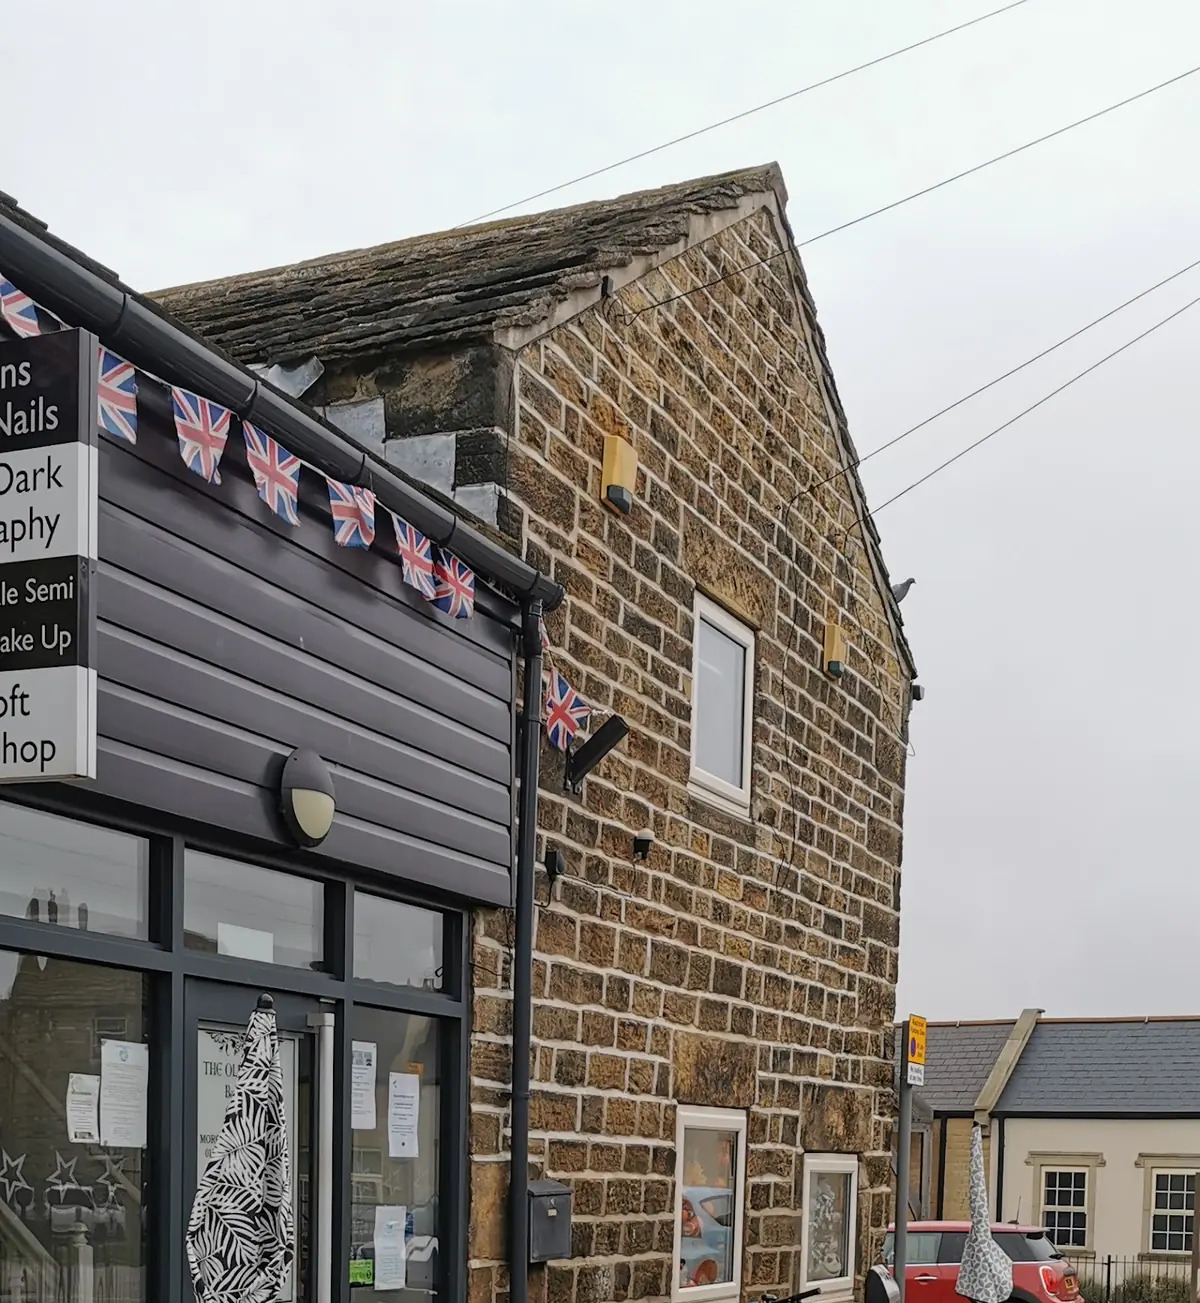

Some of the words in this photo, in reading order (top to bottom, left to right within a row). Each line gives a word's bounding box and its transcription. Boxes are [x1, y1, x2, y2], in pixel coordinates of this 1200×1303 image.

[1, 361, 32, 389] ns
[0, 581, 19, 606] le
[25, 575, 74, 603] Semi
[41, 623, 72, 656] Up
[3, 731, 57, 773] hop
[203, 1060, 223, 1076] THE
[225, 1062, 239, 1078] OL
